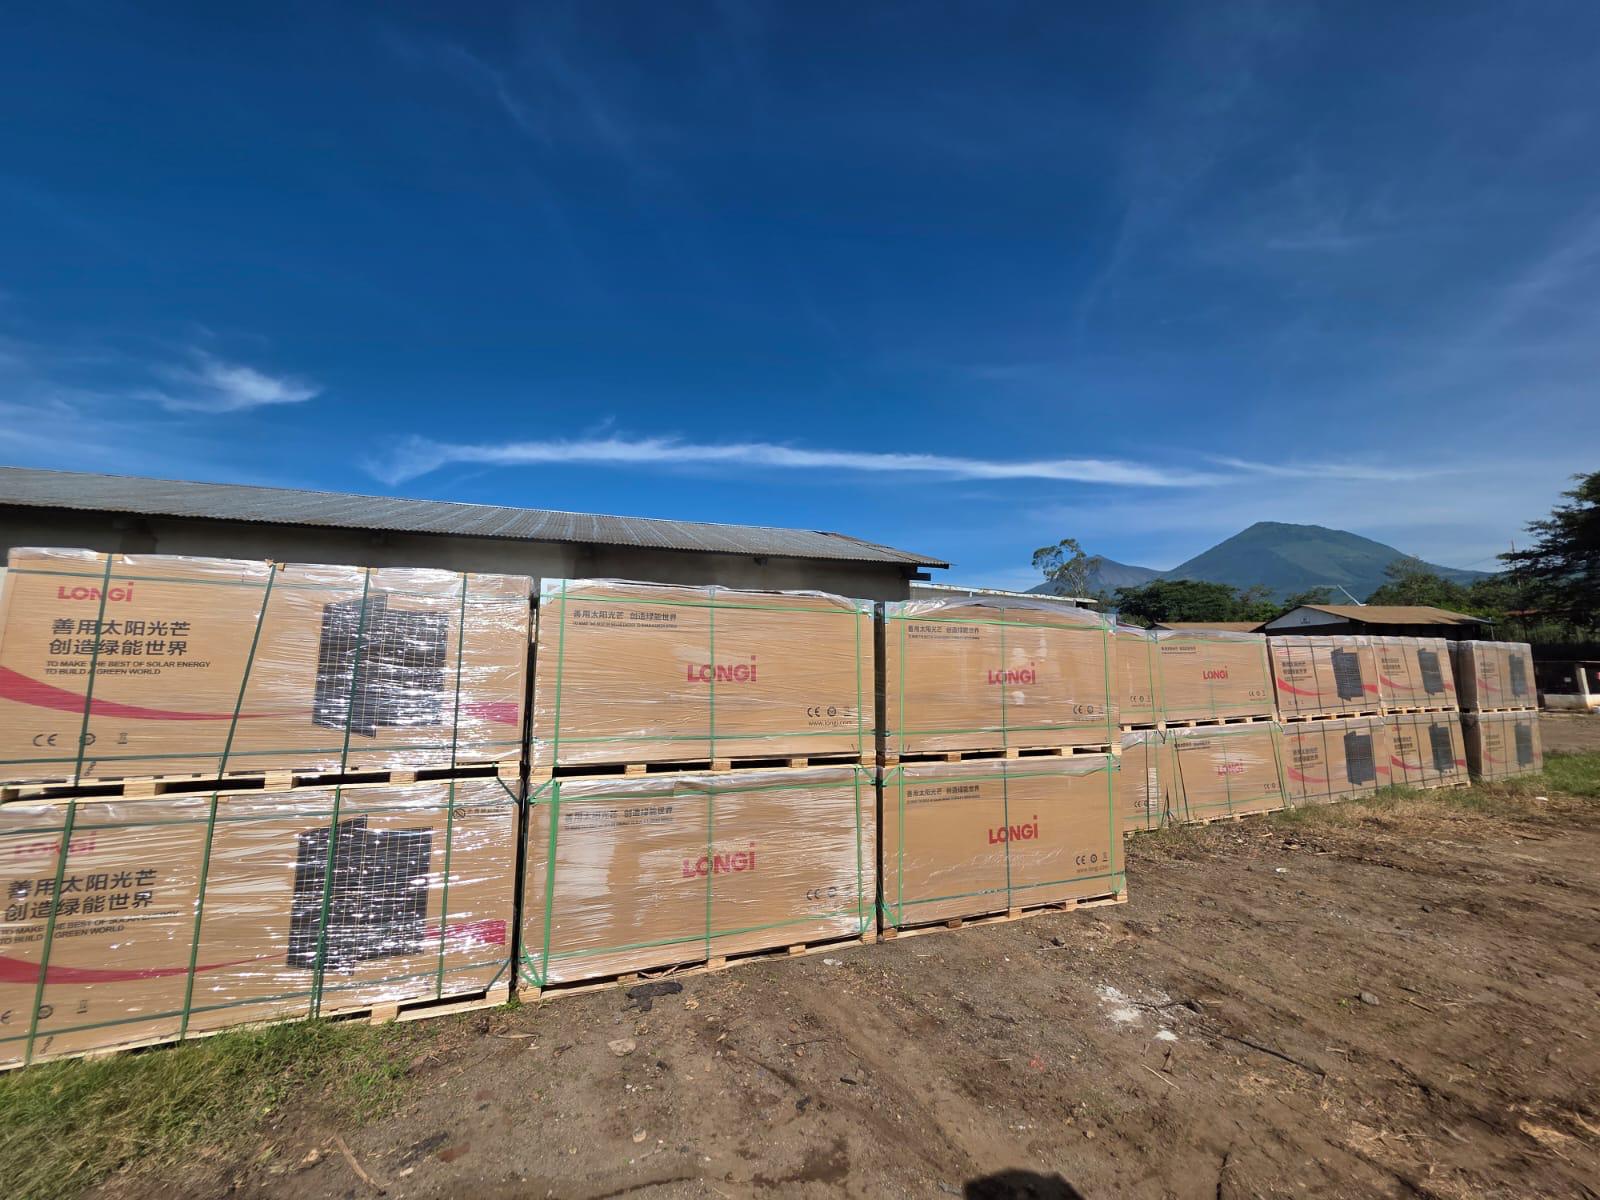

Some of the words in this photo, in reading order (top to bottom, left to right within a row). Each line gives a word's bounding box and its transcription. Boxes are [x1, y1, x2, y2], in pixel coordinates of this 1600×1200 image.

[52, 618, 191, 637] 善用太阳光芒
[49, 638, 188, 656] 创造绿能世界
[687, 655, 757, 683] LONGi
[988, 815, 1039, 844] LONGi
[8, 869, 157, 900] 善用太阳光芒
[4, 890, 153, 922] 创造绿能世界
[54, 928, 88, 939] GREEN
[90, 924, 124, 936] WORLD
